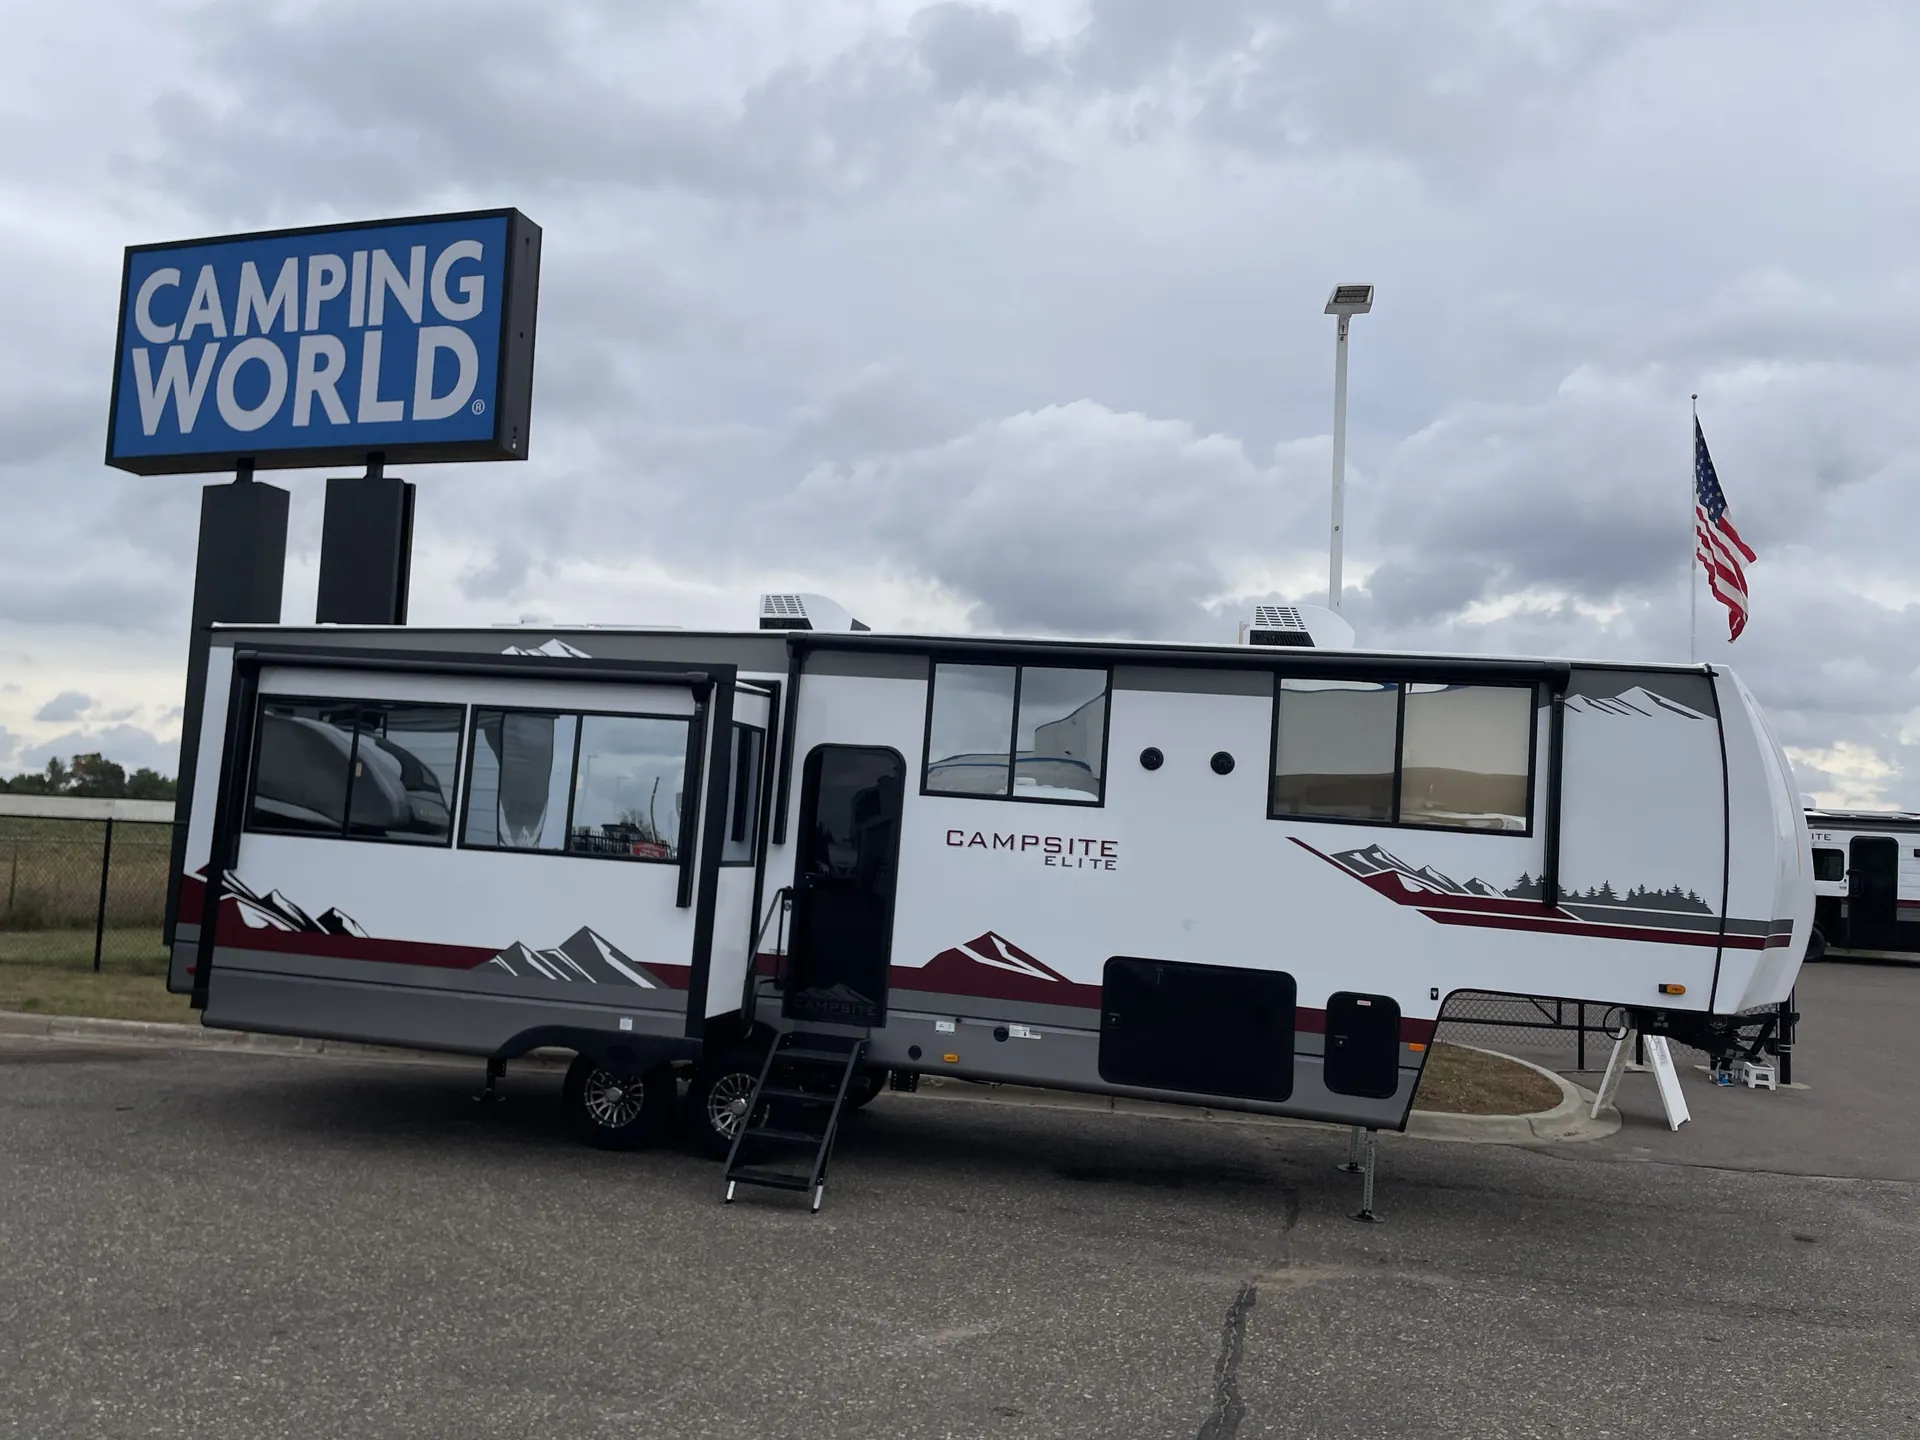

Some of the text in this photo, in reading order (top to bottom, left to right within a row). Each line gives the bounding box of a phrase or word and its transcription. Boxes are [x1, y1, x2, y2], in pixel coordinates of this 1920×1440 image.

[135, 240, 485, 344] CAMPING
[132, 326, 479, 436] WORLD
[946, 829, 1118, 858] CAMPSITE
[1044, 855, 1117, 871] ELITE
